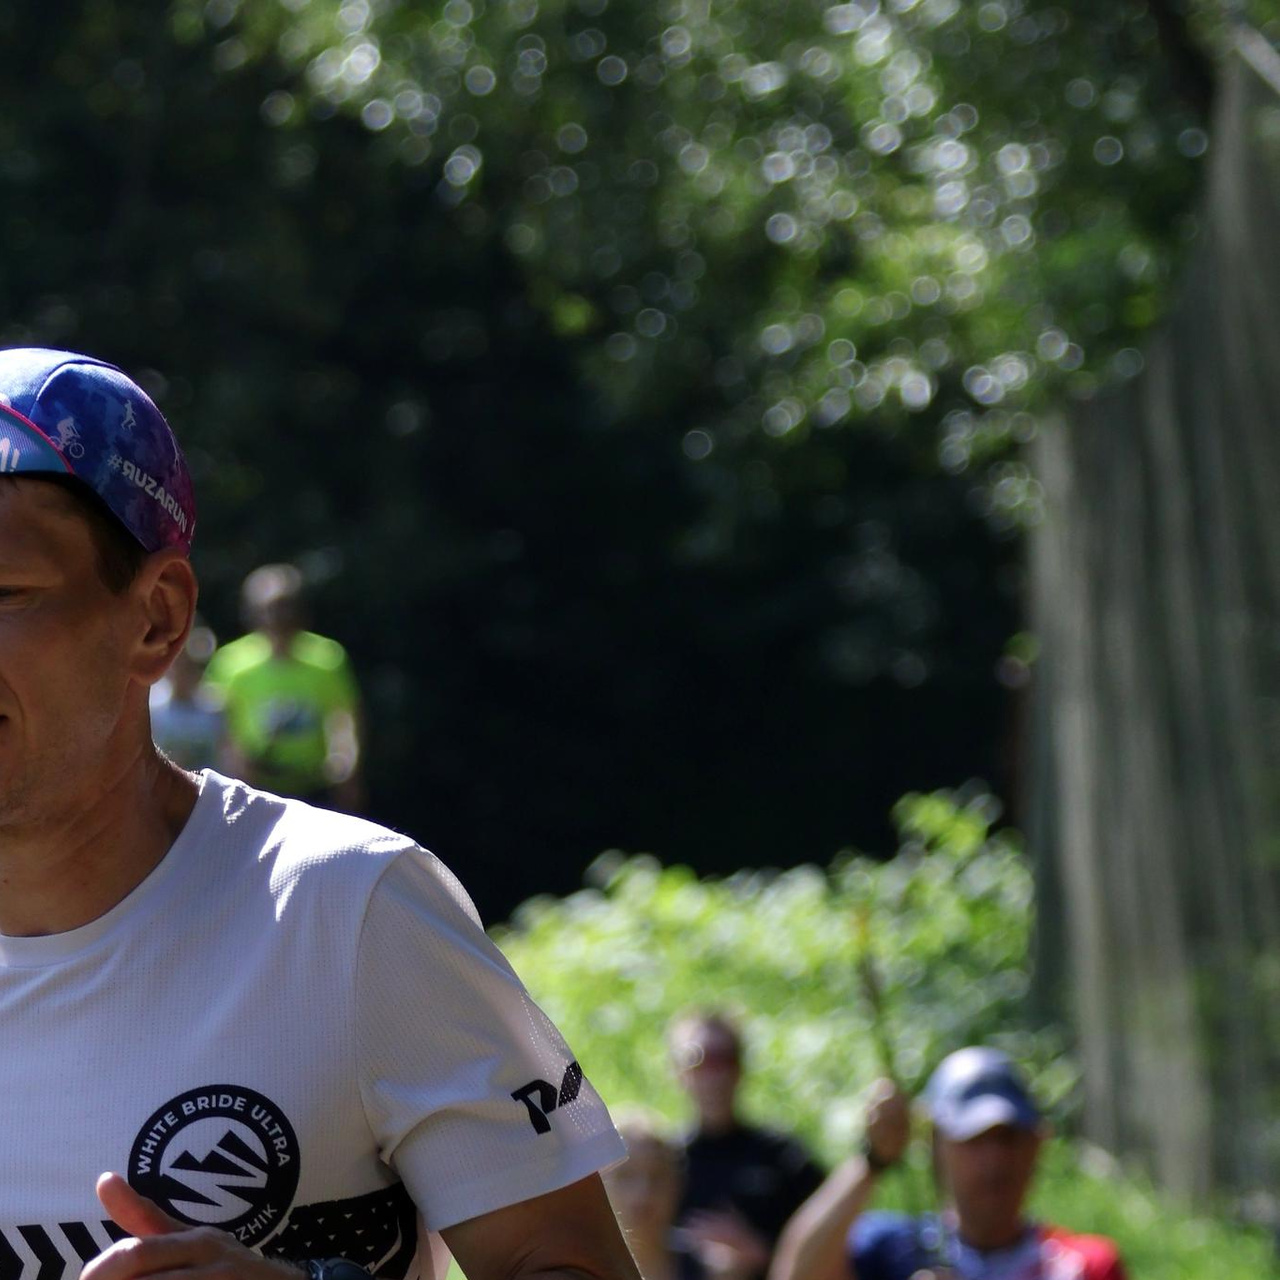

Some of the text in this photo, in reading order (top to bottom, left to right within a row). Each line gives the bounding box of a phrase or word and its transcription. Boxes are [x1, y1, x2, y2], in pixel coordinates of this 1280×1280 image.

[137, 1094, 291, 1175] WHITE BRIDE ULTRA
